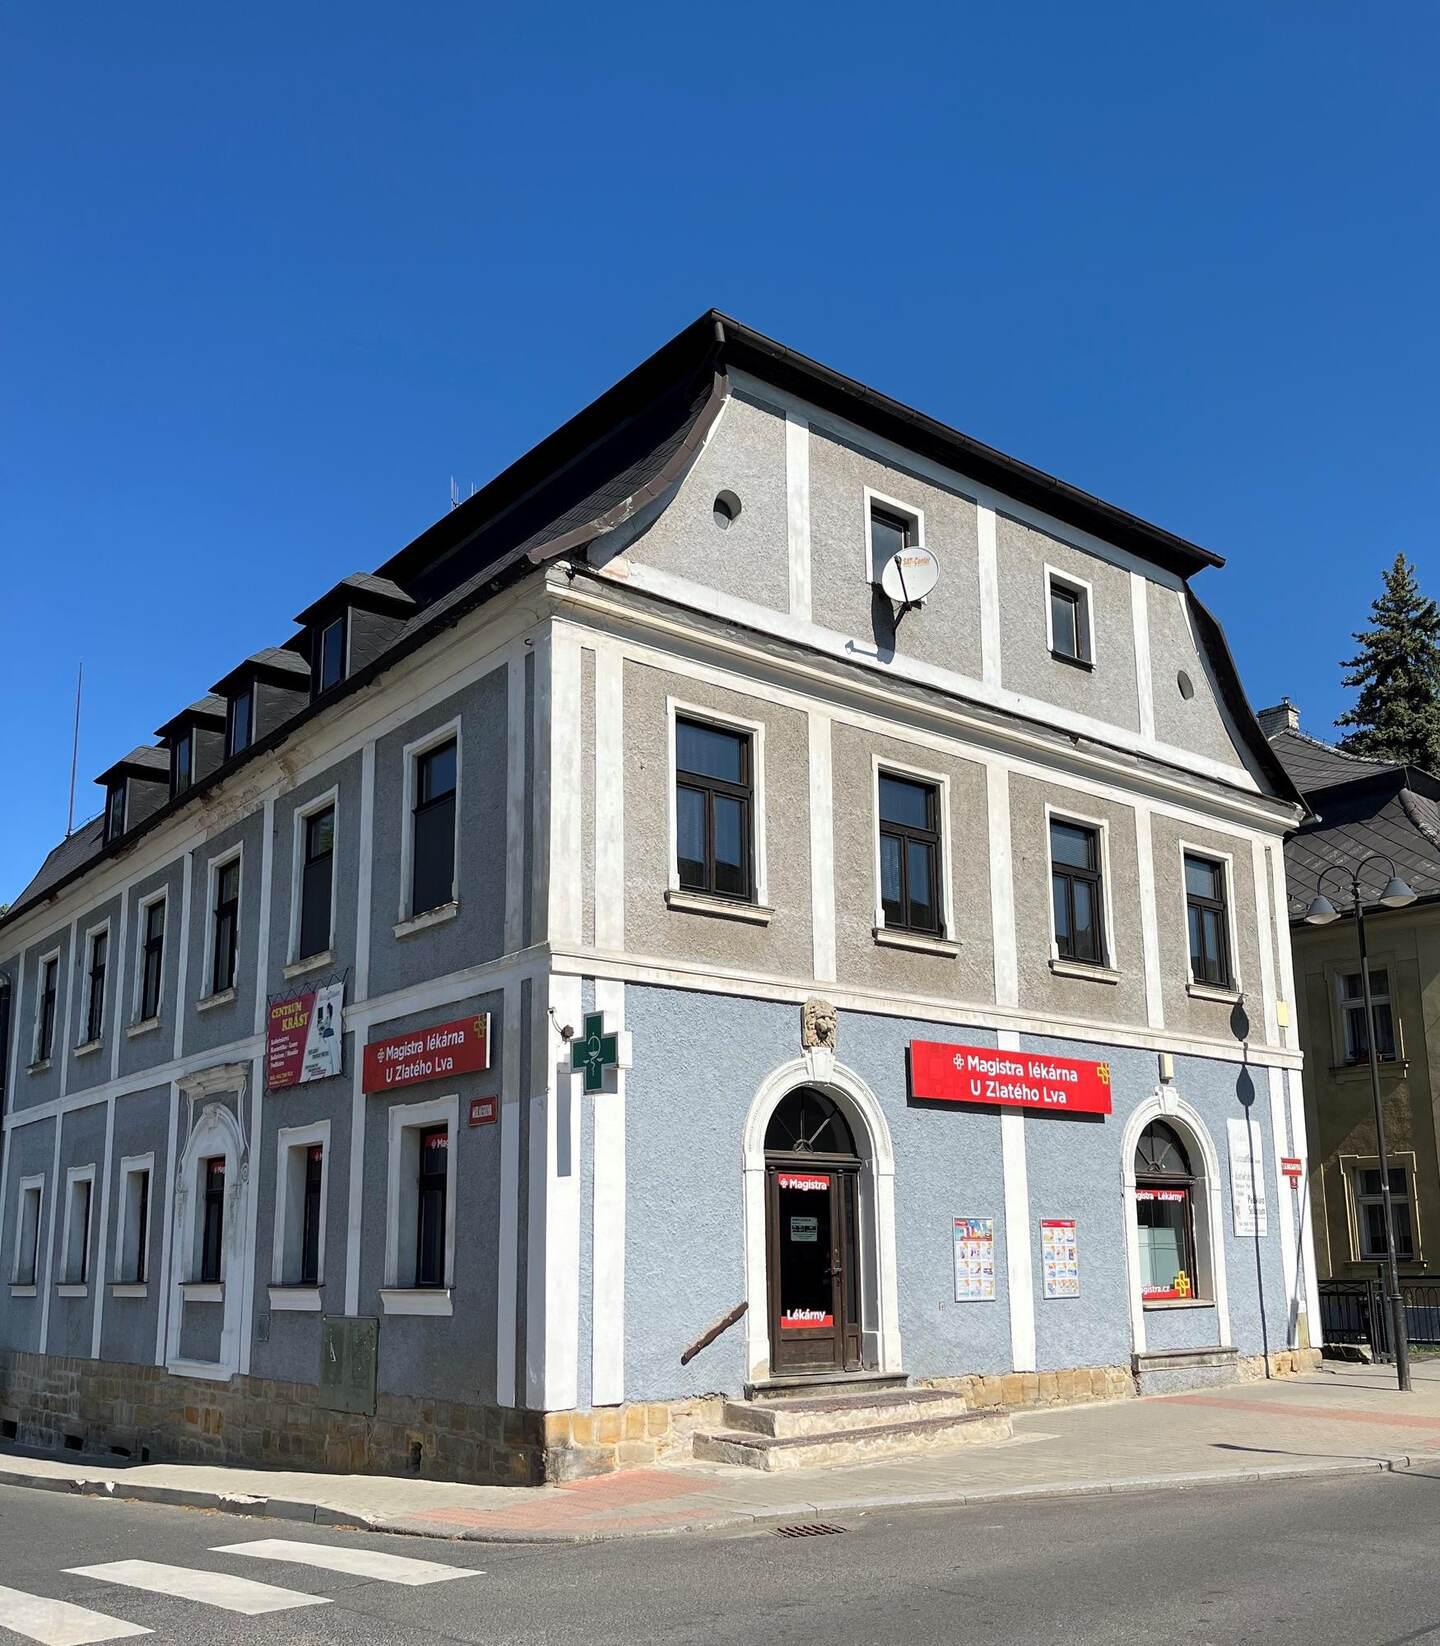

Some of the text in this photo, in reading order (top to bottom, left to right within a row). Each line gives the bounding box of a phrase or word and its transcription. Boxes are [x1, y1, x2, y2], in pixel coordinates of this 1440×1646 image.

[271, 1001, 302, 1019] CENTRUM
[385, 1030, 465, 1062] Magistra lékárna
[385, 1056, 453, 1083] U Zlatého Lva
[967, 1055, 1078, 1083] Magistra lékárna
[970, 1079, 1067, 1104] U Zlatého Lva
[789, 1178, 828, 1192] Magistra
[1157, 1190, 1182, 1203] Lékárny
[786, 1308, 826, 1322] Lékárny
